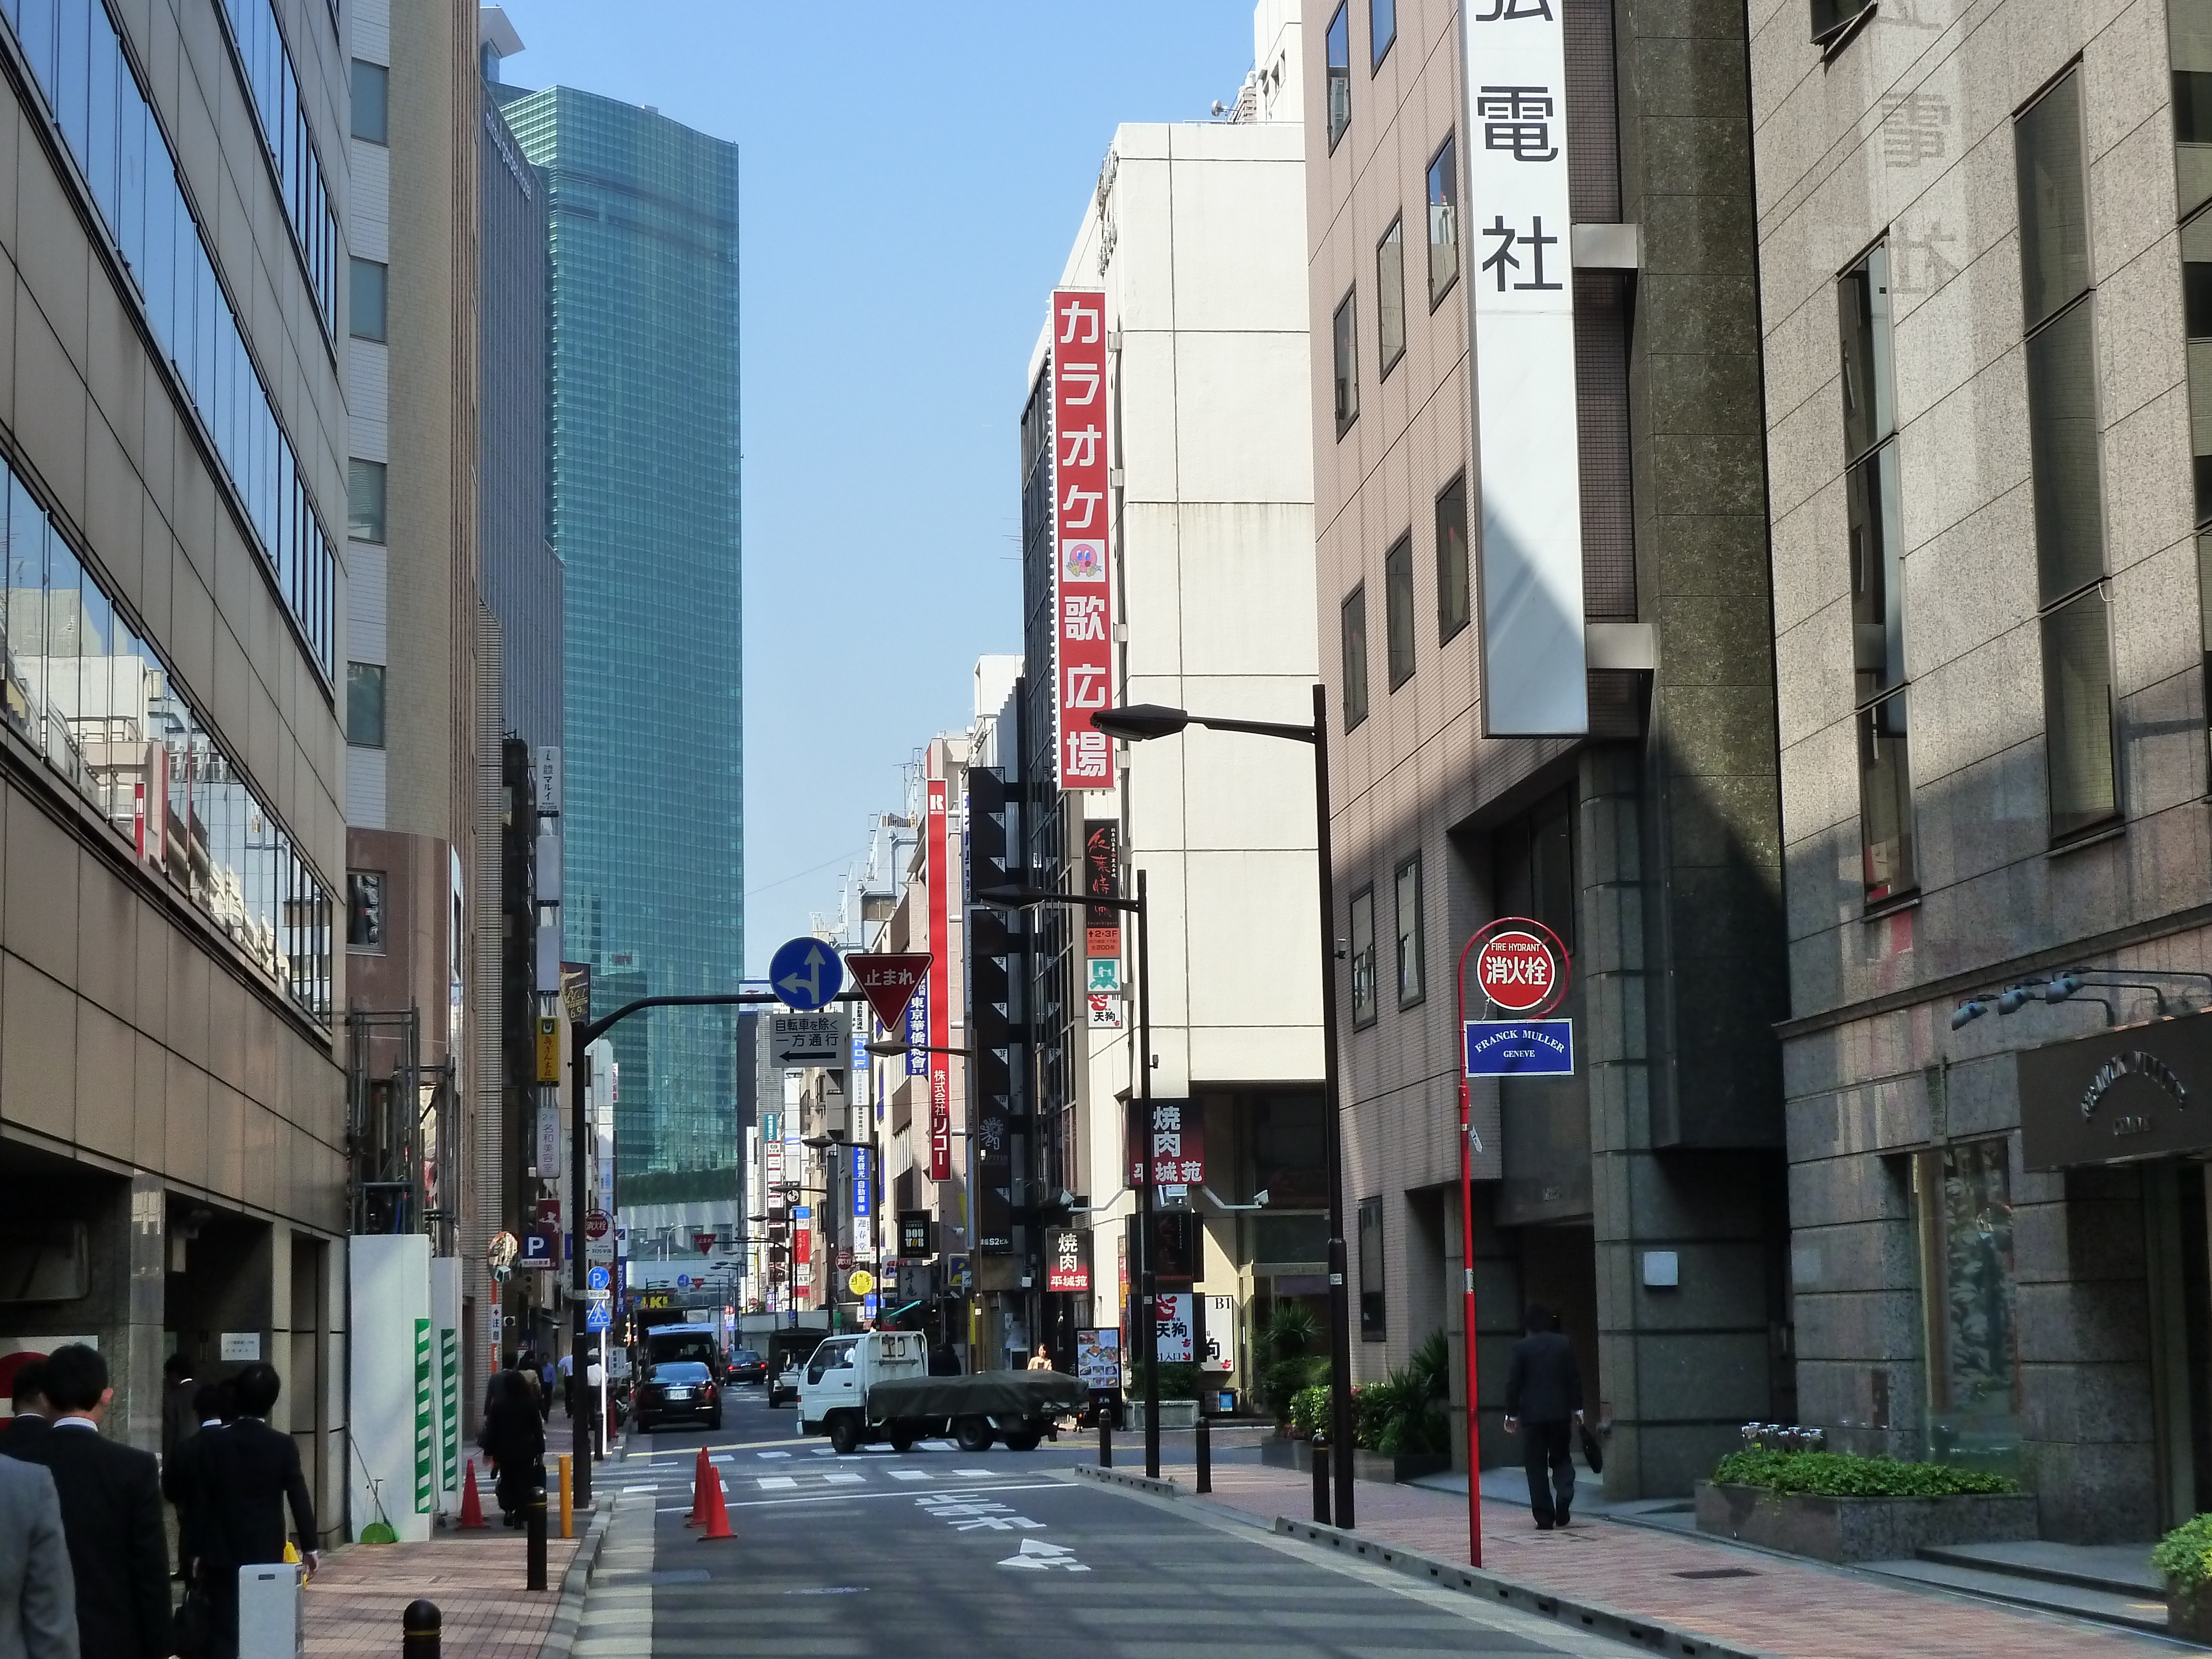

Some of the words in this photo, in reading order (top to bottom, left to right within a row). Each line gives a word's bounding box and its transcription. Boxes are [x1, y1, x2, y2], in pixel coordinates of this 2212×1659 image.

[1060, 301, 1103, 528] カラオケ
[1065, 596, 1107, 777] 歌広場
[995, 769, 1002, 777] 9F
[544, 776, 552, 800] マルイ
[996, 813, 1003, 821] 8F
[997, 858, 1003, 866] 7F
[1491, 942, 1506, 951] FIRE
[1509, 943, 1540, 952] HYDRANT
[864, 969, 915, 986] 止まれ
[1486, 956, 1548, 985] 消火栓
[999, 1003, 1005, 1011] 4F
[1094, 1011, 1116, 1022] 天狗
[776, 1019, 838, 1031] 自転車を除く
[775, 1034, 839, 1047] 一方通行
[1475, 1029, 1519, 1053] FRANCK
[1522, 1030, 1565, 1053] MULLER
[999, 1050, 1006, 1058] 3F
[1503, 1050, 1535, 1058] GENEVE
[933, 1070, 947, 1165] 株式会社リコー
[1153, 1105, 1181, 1157] 焼肉
[542, 1124, 554, 1172] 名和美容室
[586, 1222, 607, 1230] 消火栓
[528, 1237, 545, 1256] P
[1058, 1233, 1078, 1272] 焼肉
[593, 1273, 601, 1287] P
[1051, 1275, 1088, 1287] 平城苑
[1215, 1297, 1231, 1309] B1
[1156, 1322, 1187, 1338] 天狗
[915, 1494, 1047, 1531] 止まれ
